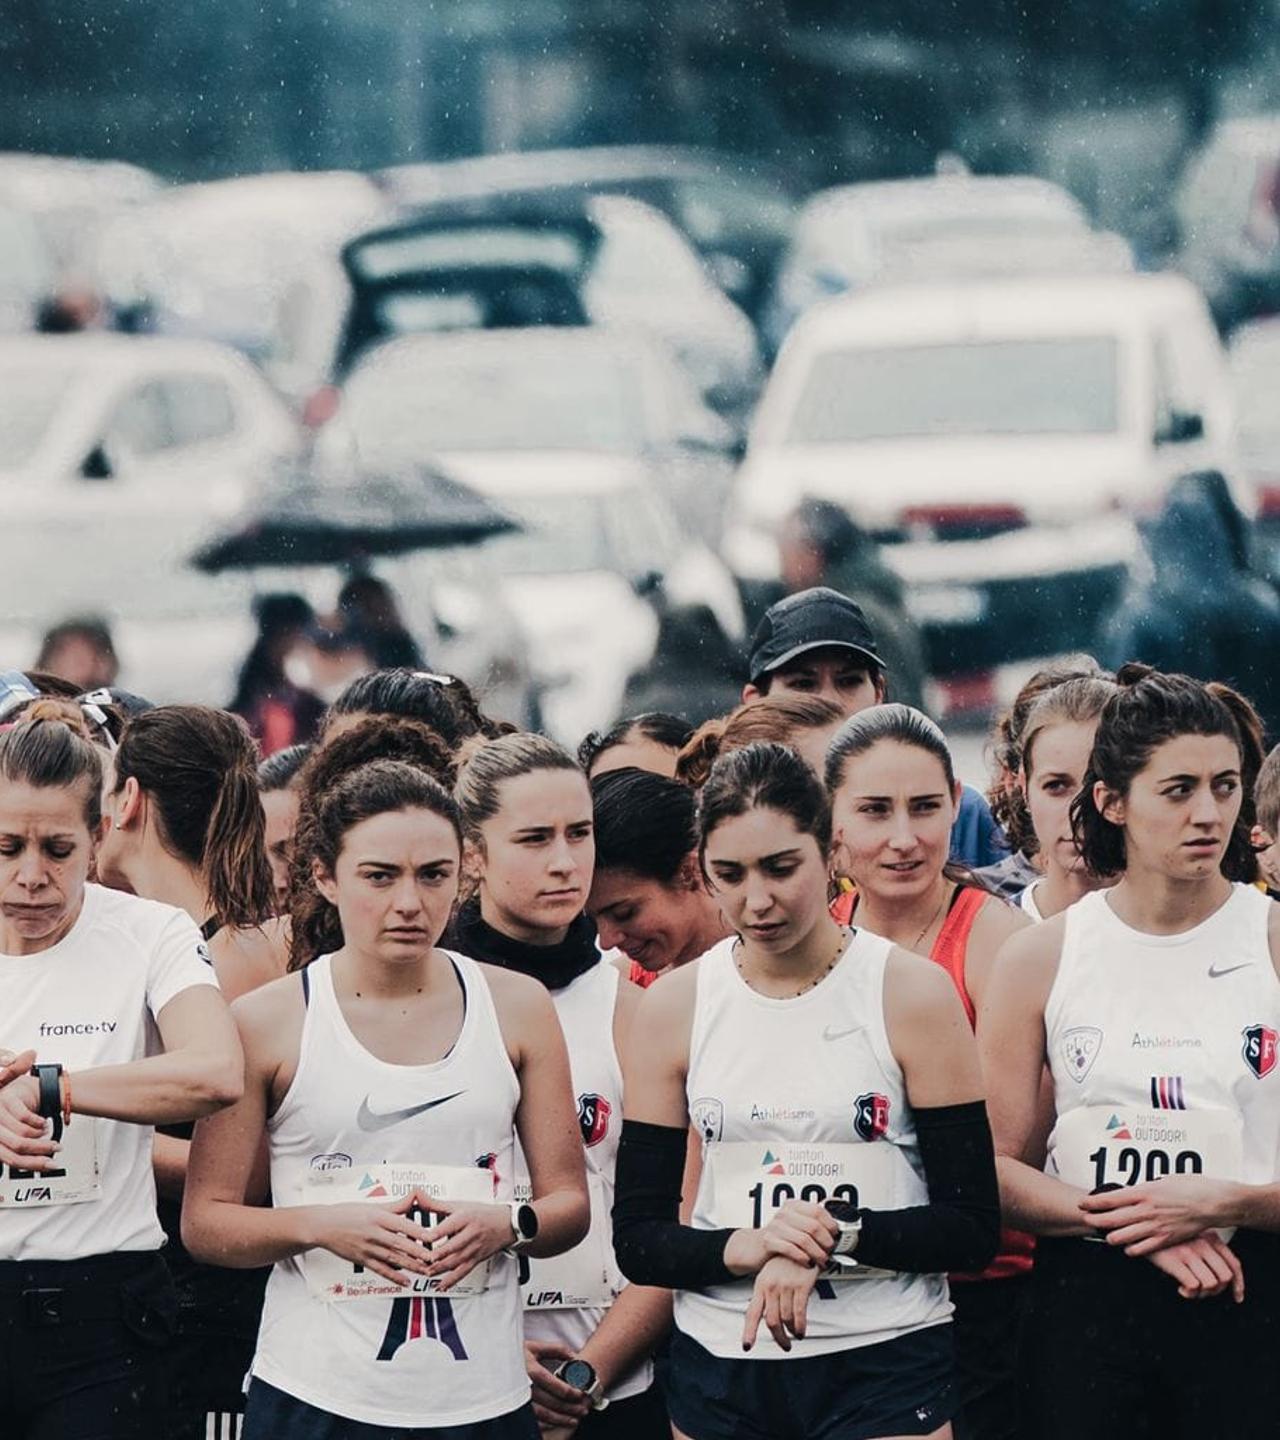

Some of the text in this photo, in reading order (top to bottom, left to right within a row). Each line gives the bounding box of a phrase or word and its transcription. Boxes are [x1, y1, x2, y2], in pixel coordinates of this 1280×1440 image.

[1134, 1127, 1182, 1143] OUTDOOR
[788, 1162, 839, 1177] OUTDOOR
[14, 1187, 52, 1202] LIFA
[526, 1290, 564, 1307] LIFA
